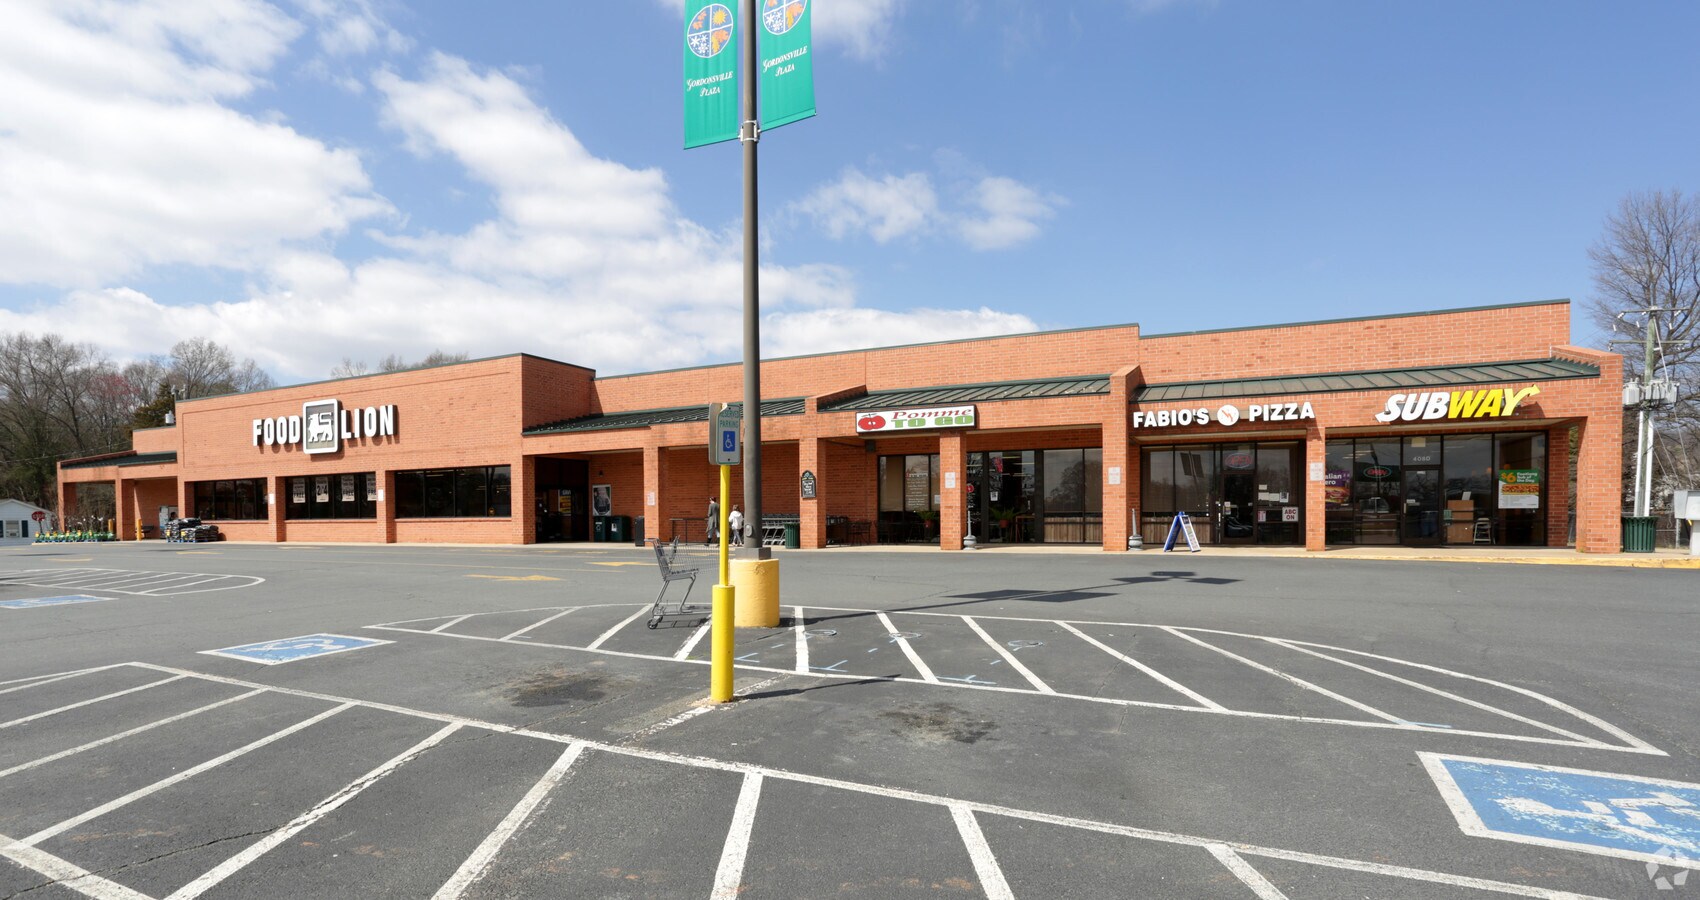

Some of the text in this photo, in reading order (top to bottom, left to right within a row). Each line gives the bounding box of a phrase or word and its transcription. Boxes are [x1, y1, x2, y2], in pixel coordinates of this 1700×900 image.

[763, 45, 808, 73] GORDONSVILLE
[775, 64, 795, 77] PLAZA
[687, 71, 733, 92] GORDONSVILLE
[700, 87, 721, 97] PLAZA
[1375, 384, 1541, 423] SUBWAY
[892, 408, 972, 419] Pomme
[1133, 402, 1315, 428] FABIO'S PIZZA
[252, 404, 395, 447] FOOD LION
[720, 420, 739, 428] PARKING
[891, 415, 974, 429] TO GO
[1501, 472, 1517, 483] $6
